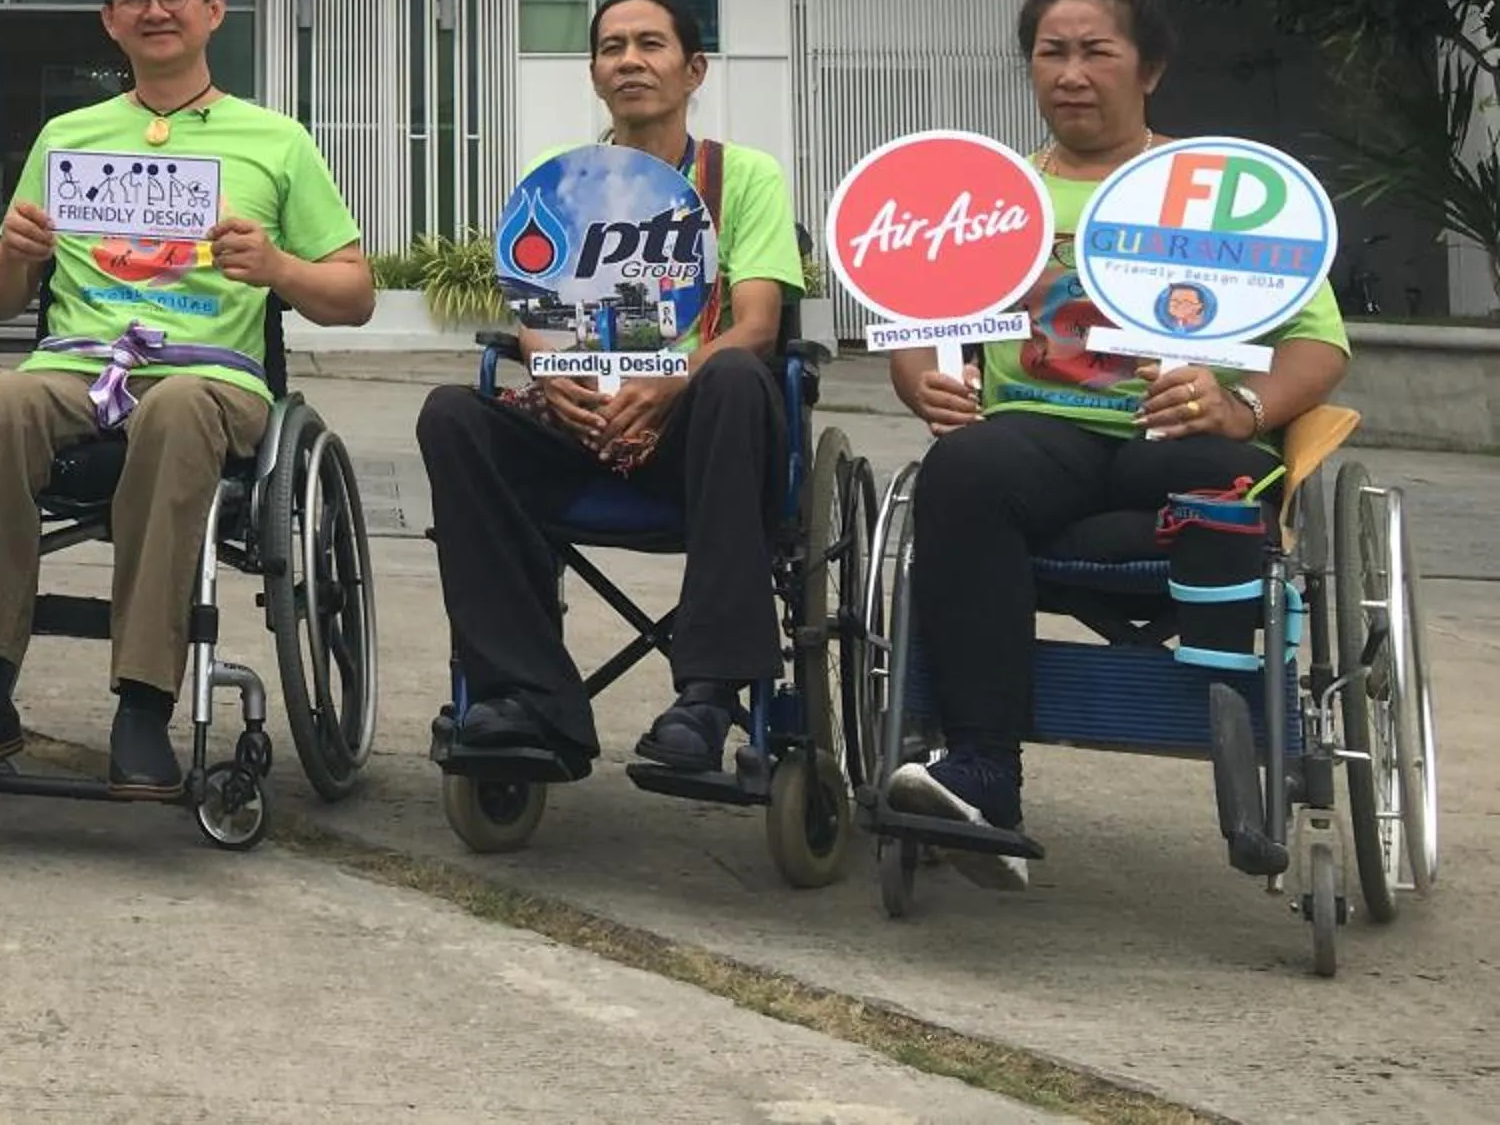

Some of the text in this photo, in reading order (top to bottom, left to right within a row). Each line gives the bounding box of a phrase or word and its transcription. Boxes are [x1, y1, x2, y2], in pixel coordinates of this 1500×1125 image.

[1158, 152, 1288, 233] FD
[58, 204, 206, 227] FRIENDLY DESIGN
[575, 206, 711, 280] ptt
[1091, 227, 1315, 269] GUARANTEE
[621, 260, 699, 282] Group
[1104, 261, 1285, 289] Friendly Design 2018
[532, 355, 687, 376] Friendly Design
